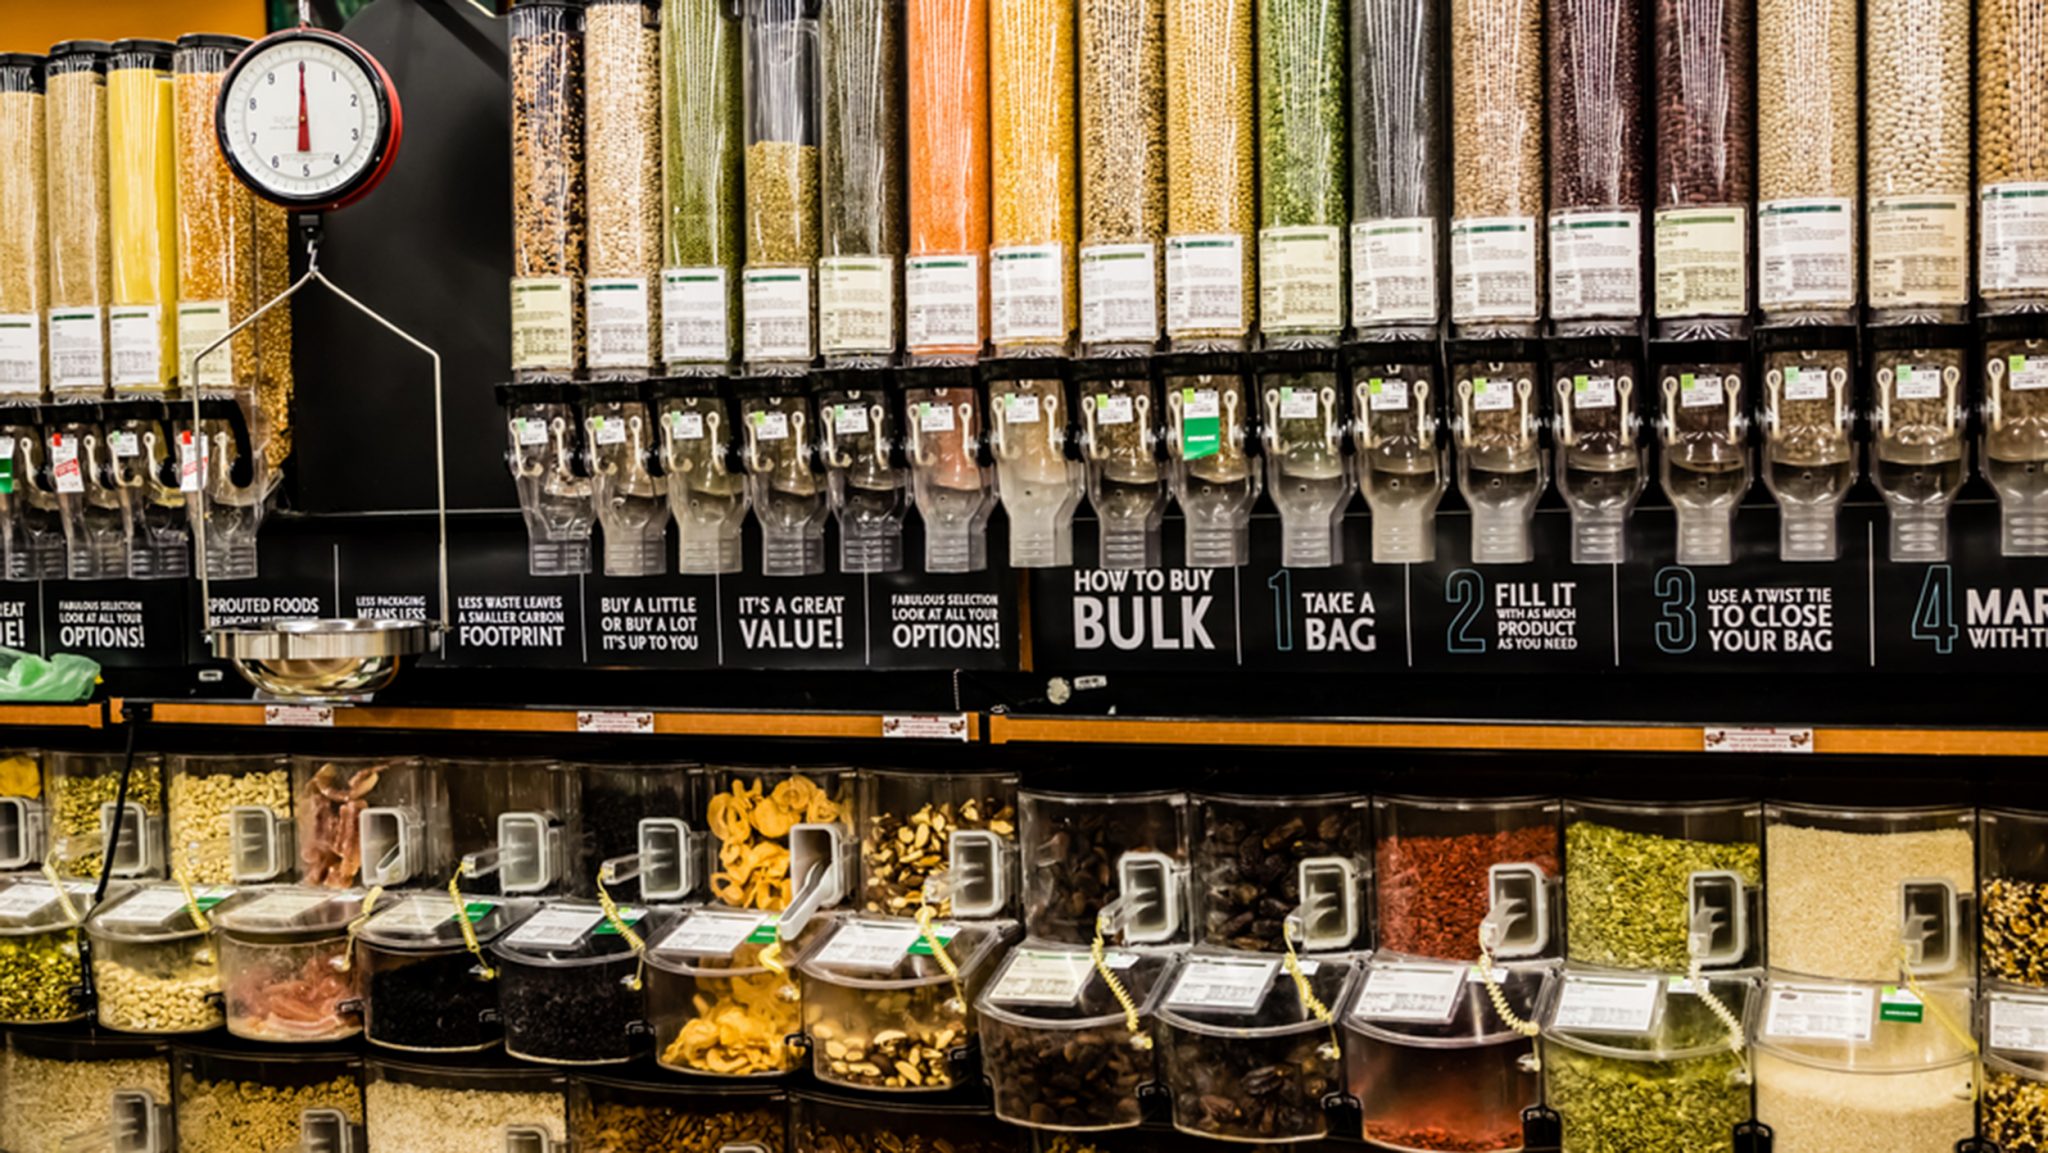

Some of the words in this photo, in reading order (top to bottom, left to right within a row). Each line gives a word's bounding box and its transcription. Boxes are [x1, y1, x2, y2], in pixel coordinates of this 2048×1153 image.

[267, 72, 275, 85] 9
[331, 71, 337, 82] 1
[249, 97, 257, 110] 8
[350, 94, 358, 107] 2
[250, 132, 257, 144] 7
[351, 128, 359, 141] 3
[271, 156, 279, 168] 6
[333, 154, 341, 166] 4
[302, 164, 310, 177] 5
[1073, 569, 1130, 592] HOW
[1131, 569, 1165, 592] TO
[1169, 568, 1214, 592] BUY
[356, 596, 376, 608] LESS
[377, 596, 426, 608] PACKAGING
[457, 596, 483, 609] LESS
[484, 596, 521, 609] WASTE
[523, 596, 563, 609] LEAVES
[891, 594, 945, 606] FABULOUS
[947, 594, 999, 606] SELECTION
[1301, 592, 1355, 614] TAKE
[1359, 591, 1376, 614] A
[1495, 582, 1547, 607] FILL
[1551, 582, 1577, 607] IT
[1708, 588, 1738, 604] USE
[1741, 588, 1753, 603] A
[1755, 588, 1804, 603] TWIST
[1806, 587, 1832, 603] TIE
[0, 601, 26, 617] EAT
[59, 601, 99, 611] FABULOUS
[100, 601, 142, 611] SELECTION
[273, 597, 320, 614] FOODS
[601, 597, 631, 614] BUY
[633, 597, 645, 613] A
[648, 596, 697, 613] LITTLE
[739, 596, 771, 614] IT'S
[774, 597, 787, 614] A
[790, 596, 845, 614] GREAT
[1268, 569, 1293, 652] 1
[1445, 569, 1486, 653] 2
[1496, 608, 1525, 619] WITH
[1526, 608, 1541, 619] AS
[1542, 607, 1576, 620] MUCH
[1654, 566, 1697, 653] 3
[1912, 564, 1959, 654] 4
[59, 613, 84, 624] LOOK
[86, 613, 97, 623] AT
[98, 613, 115, 624] ALL
[116, 613, 142, 624] YOUR
[357, 609, 398, 620] MEANS
[399, 609, 427, 620] LESS
[458, 611, 466, 623] A
[468, 611, 517, 624] SMALLER
[518, 611, 564, 624] CARBON
[892, 607, 925, 621] LOOK
[927, 607, 943, 621] AT
[944, 608, 966, 621] ALL
[968, 607, 998, 621] YOUR
[1073, 595, 1216, 650] BULK
[1707, 604, 1745, 628] TO
[1750, 603, 1833, 628] CLOSE
[601, 616, 622, 632] OR
[625, 616, 653, 632] BUY
[656, 617, 667, 632] A
[669, 616, 697, 632] LOT
[739, 615, 844, 650] VALUE!
[1497, 620, 1576, 637] PRODUCT
[60, 625, 145, 648] OPTIONS!
[460, 625, 565, 647] FOOTPRINT
[602, 634, 627, 650] IT'S
[628, 635, 647, 650] UP
[648, 634, 668, 650] TO
[669, 635, 699, 651] YOU
[892, 621, 1001, 650] OPTIONS!
[1304, 617, 1377, 652] BAG
[1708, 629, 1777, 652] YOUR
[1783, 628, 1833, 652] BAG
[1967, 628, 2029, 649] WITH
[2030, 628, 2048, 649] T
[1497, 637, 1513, 650] AS
[1515, 637, 1542, 650] YOU
[1544, 637, 1578, 650] NEED
